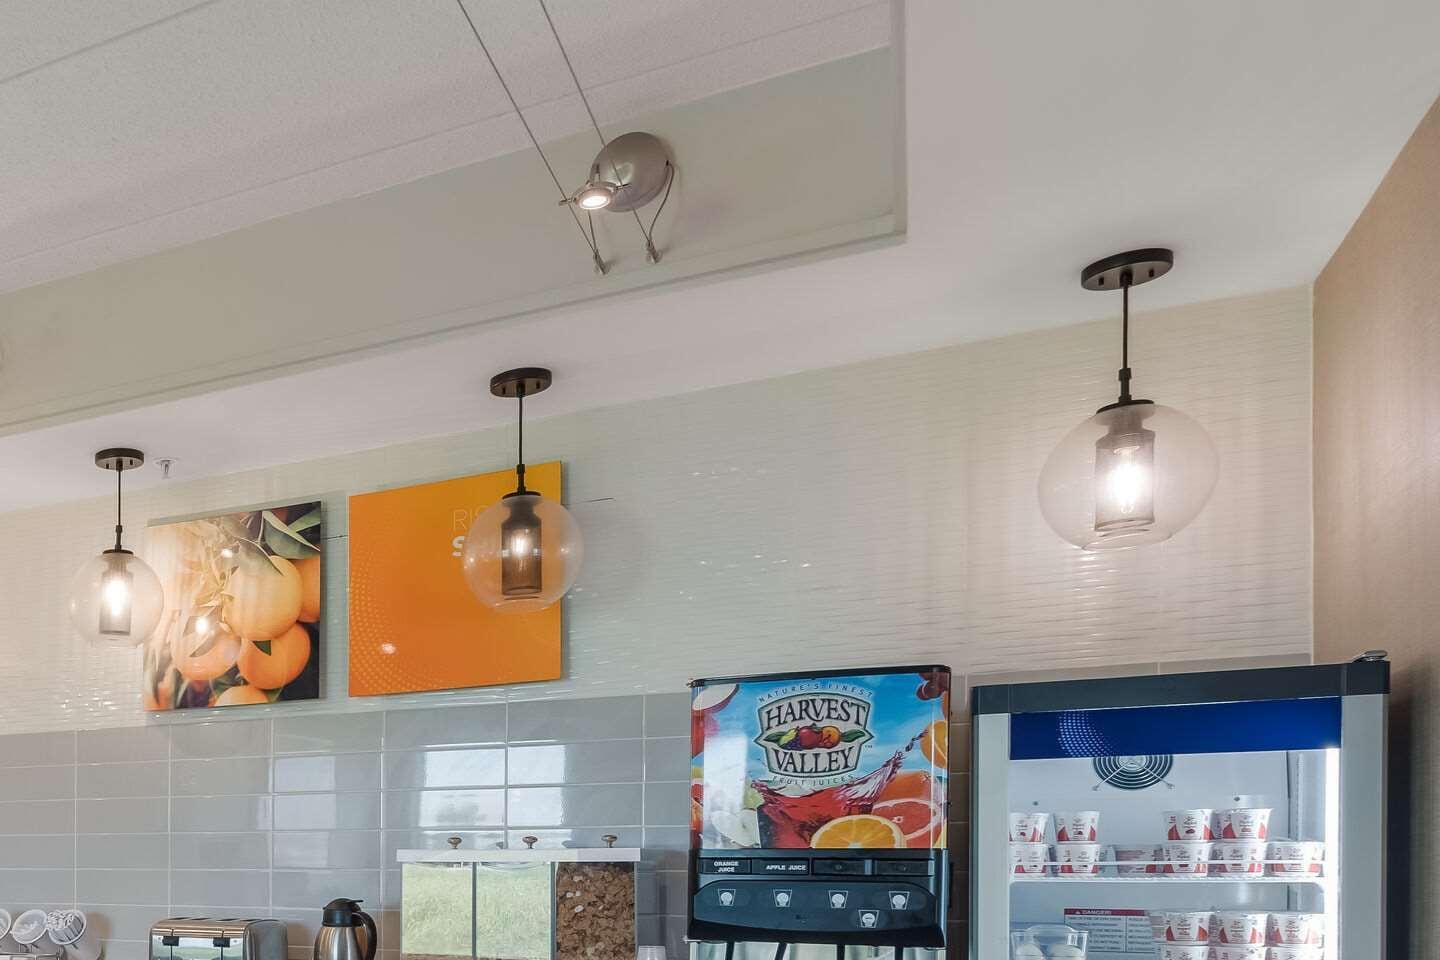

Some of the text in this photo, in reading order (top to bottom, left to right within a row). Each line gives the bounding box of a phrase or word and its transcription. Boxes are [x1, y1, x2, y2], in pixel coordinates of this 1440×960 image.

[828, 684, 873, 698] FINEST
[765, 698, 867, 731] HARVEST
[771, 746, 855, 773] VALLEY
[772, 774, 855, 786] FRUIT JUICES
